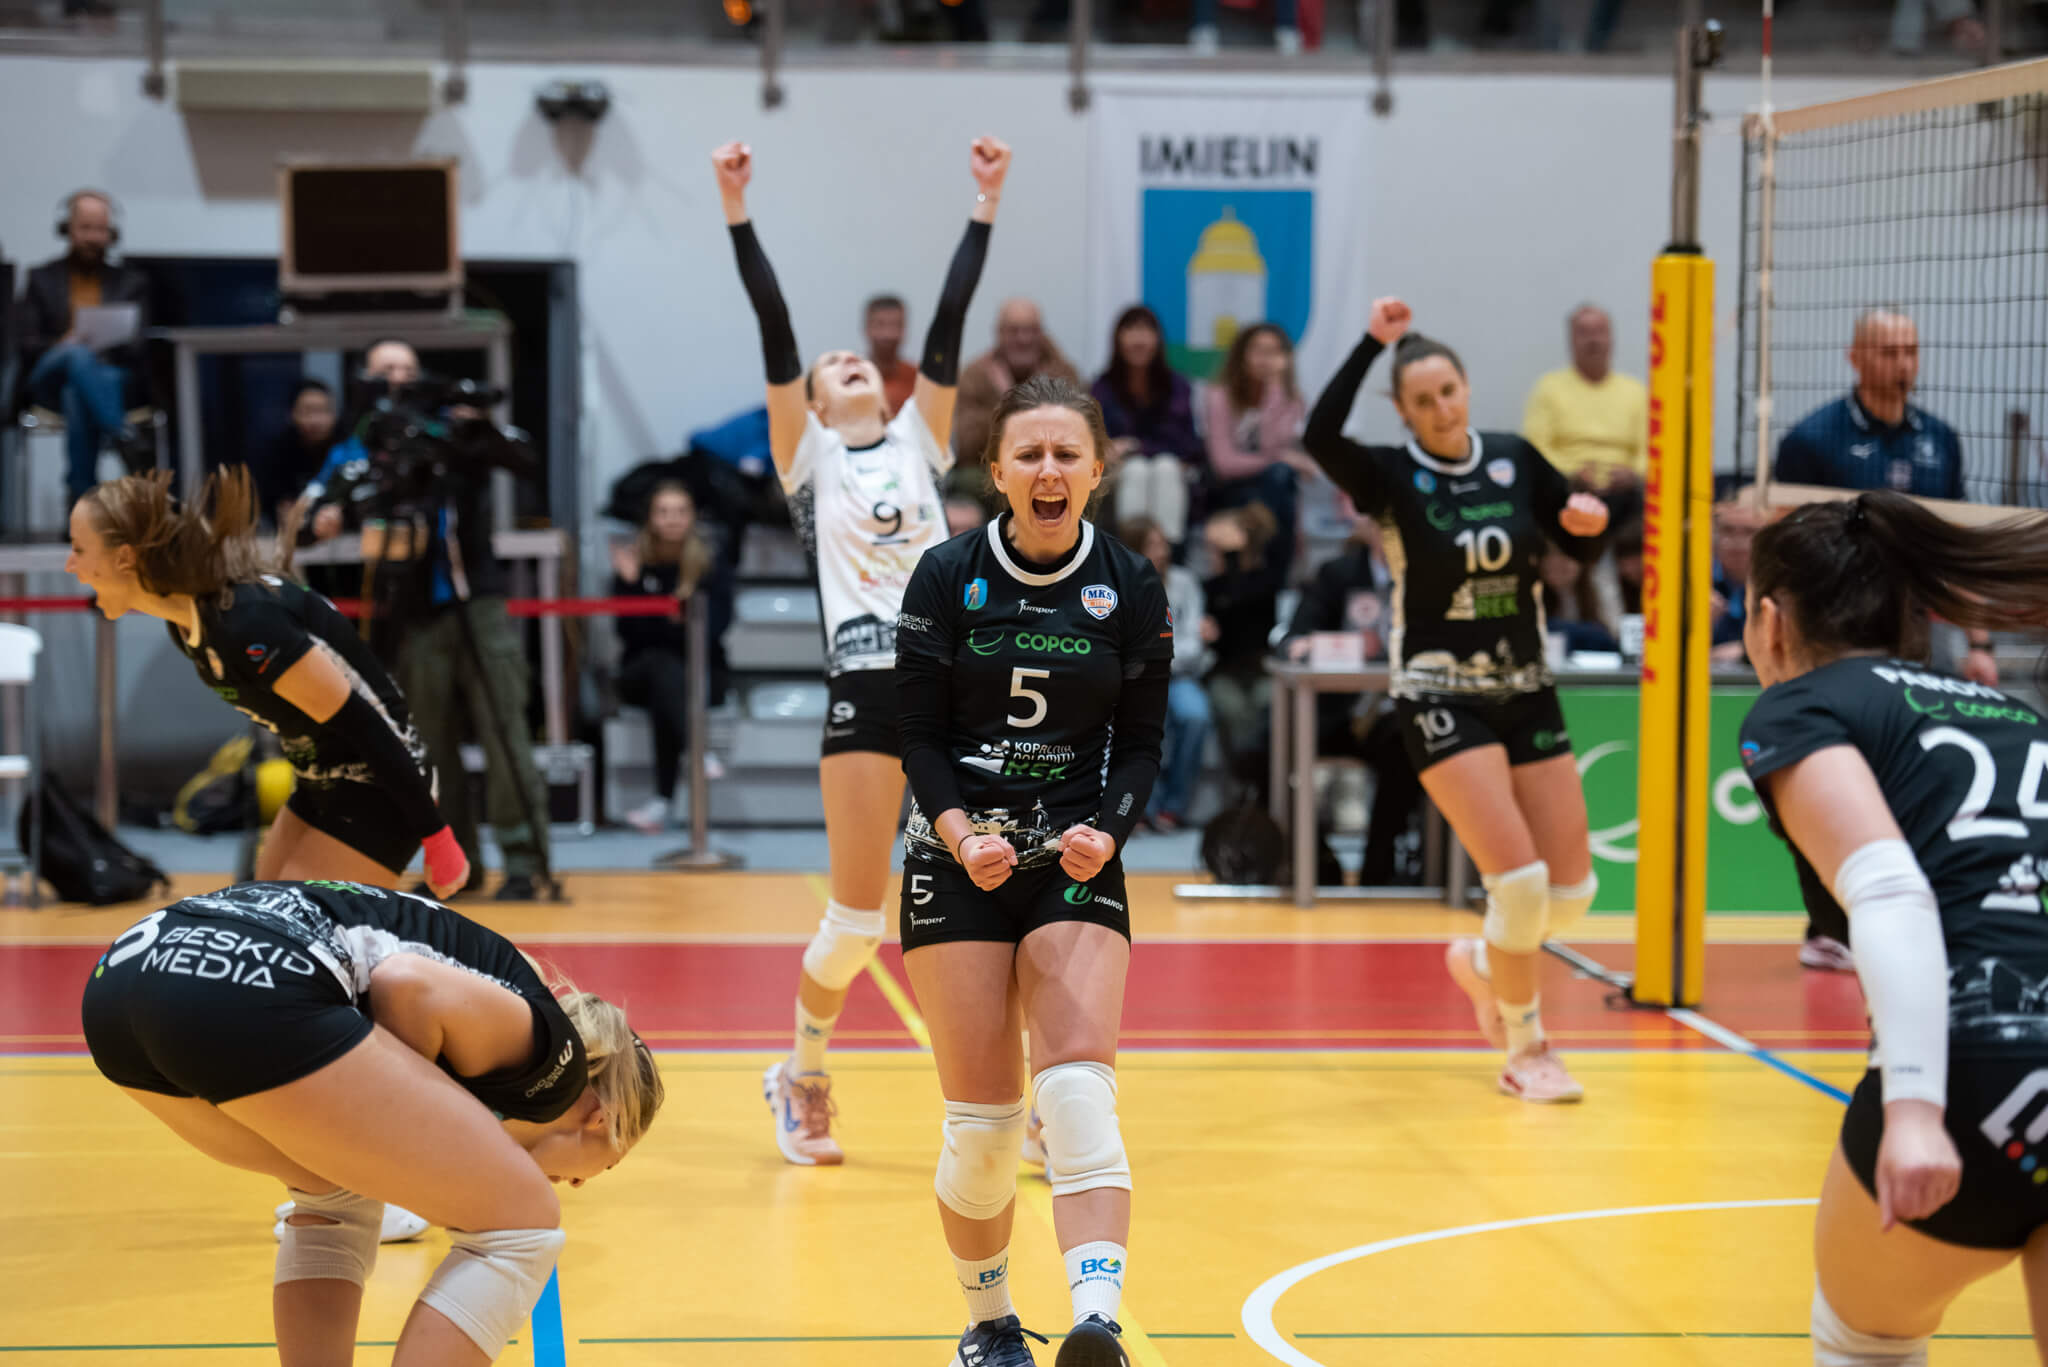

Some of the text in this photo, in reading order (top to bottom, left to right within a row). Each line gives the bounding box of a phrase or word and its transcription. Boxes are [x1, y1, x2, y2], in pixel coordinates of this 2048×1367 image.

[1140, 135, 1318, 178] IMIELIN
[874, 502, 902, 538] 9
[1455, 526, 1512, 573] 10
[1088, 590, 1112, 601] MKS
[1015, 632, 1092, 655] COPCO
[833, 701, 856, 724] 9
[1007, 667, 1050, 728] 5
[1414, 709, 1456, 740] 10
[911, 874, 933, 905] 5
[1094, 895, 1124, 911] URANOS
[160, 926, 316, 976] BESKID
[141, 948, 275, 989] MEDIA
